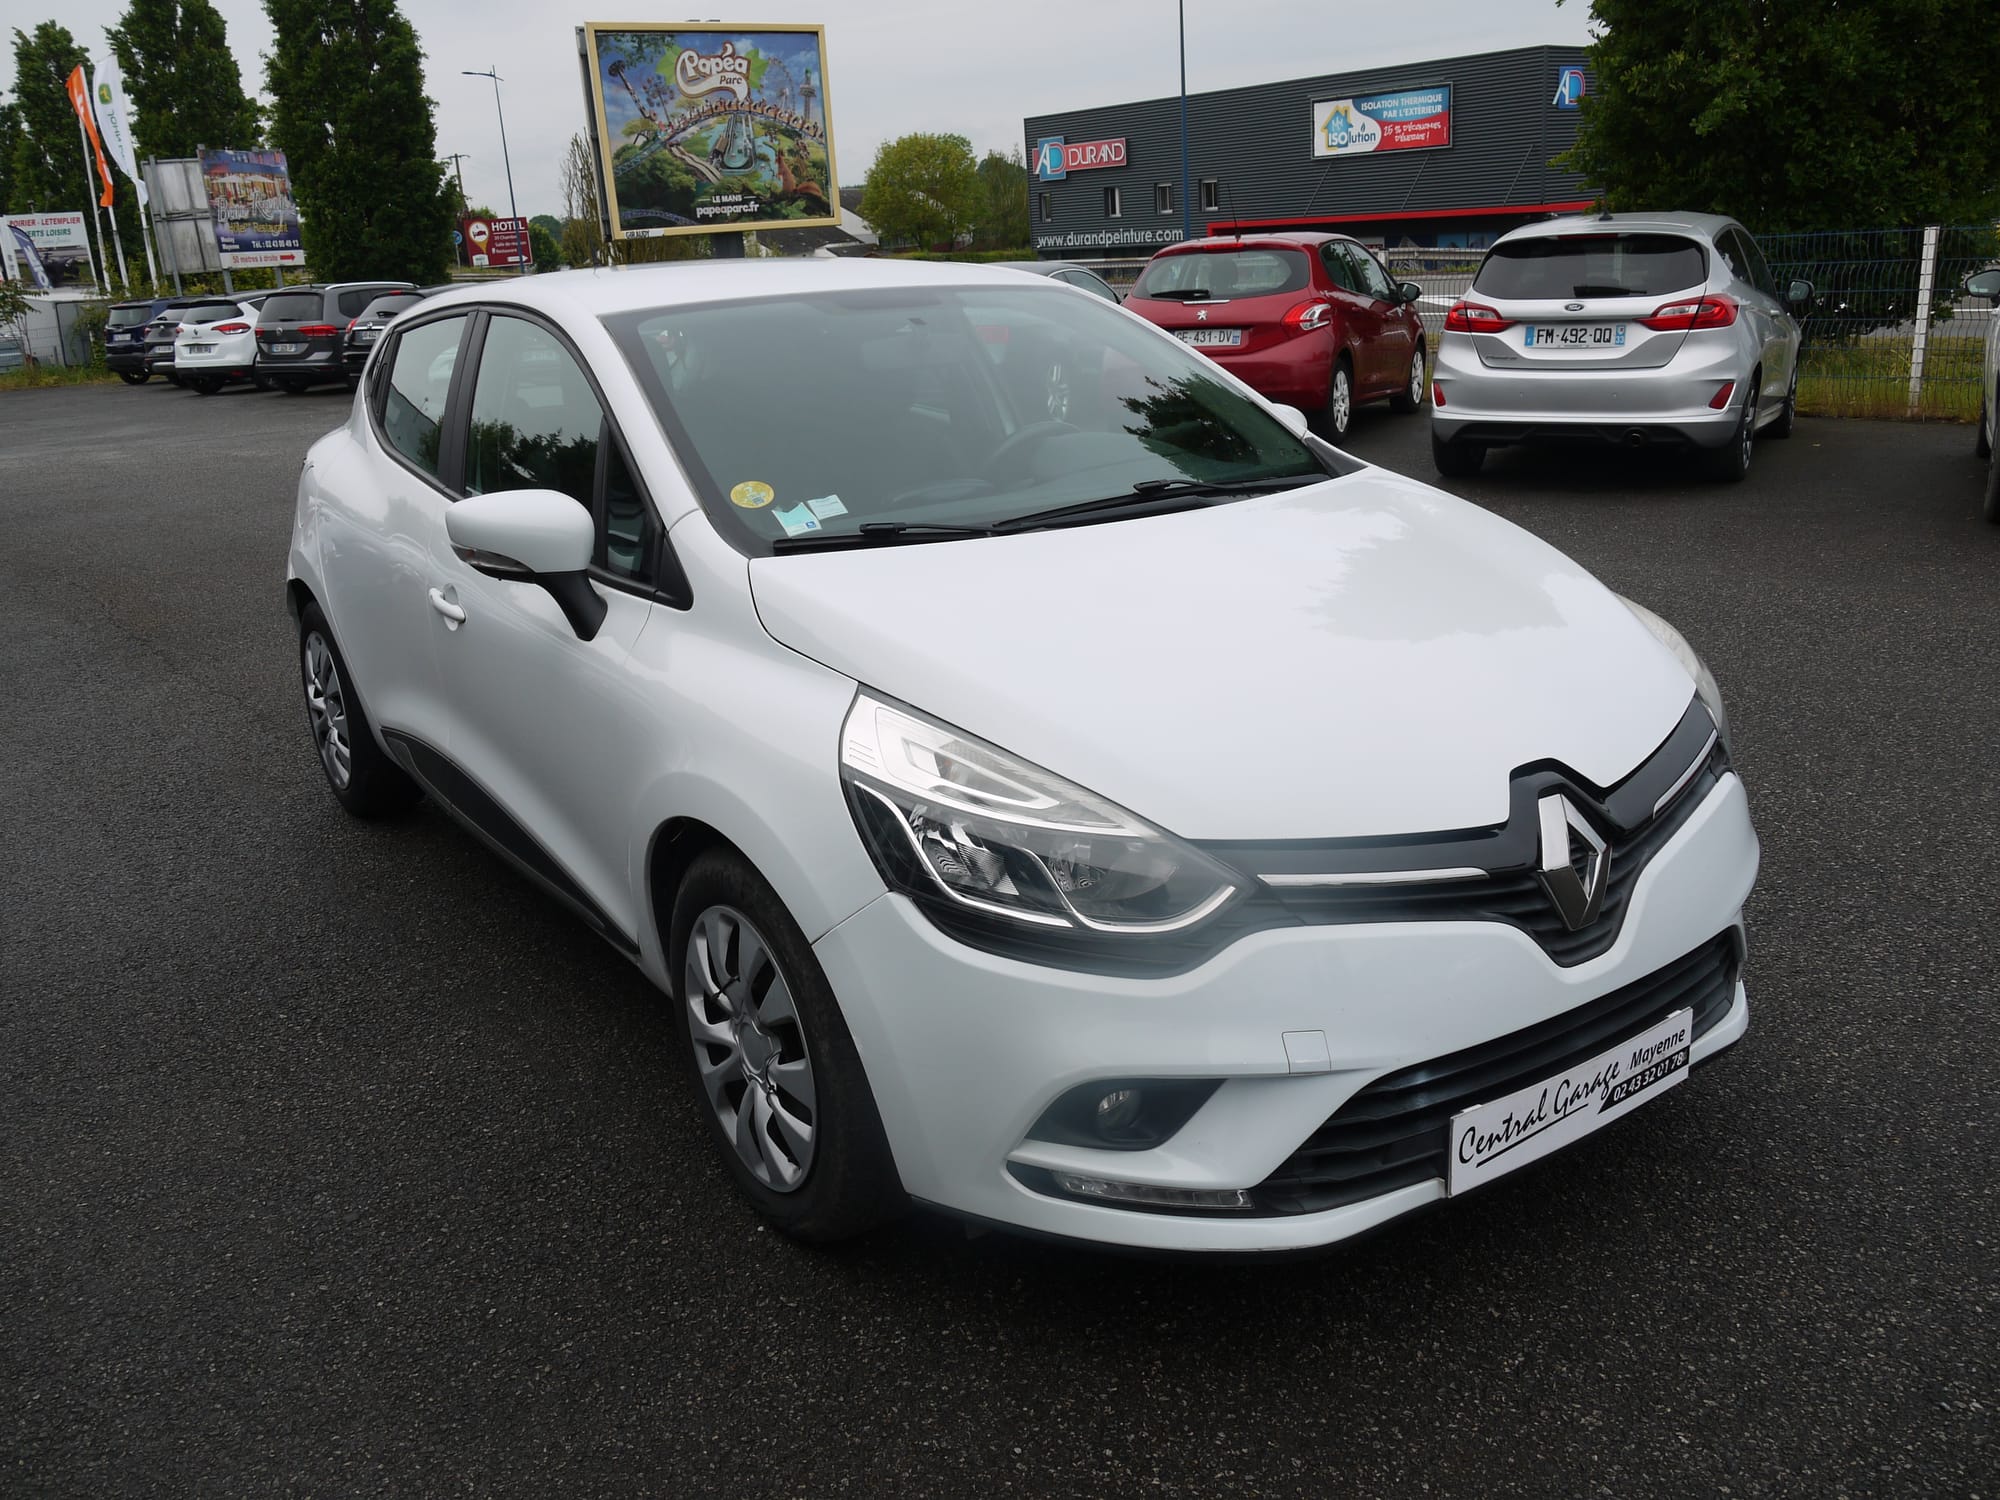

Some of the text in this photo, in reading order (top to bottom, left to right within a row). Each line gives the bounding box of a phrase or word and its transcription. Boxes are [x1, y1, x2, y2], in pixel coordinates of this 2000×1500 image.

[676, 43, 748, 78] Papéa
[720, 75, 742, 84] Parc
[1361, 93, 1443, 111] ISOLATION THERMIQUE
[1383, 110, 1398, 119] PAR
[1036, 142, 1125, 175] AD DURAND
[712, 194, 742, 203] LE MANS
[696, 201, 759, 218] papeaparc.fr
[9, 218, 36, 227] POIRIER
[41, 216, 81, 226] LETEMPLIER
[27, 228, 72, 238] ERTS LOISIRS
[1037, 228, 1184, 248] www.durandpeinture.com
[1536, 327, 1612, 345] FM-492-QQ
[1613, 1051, 1684, 1101] 02 43 32 01 78
[1458, 1029, 1686, 1165] Central Garage Mayenne
